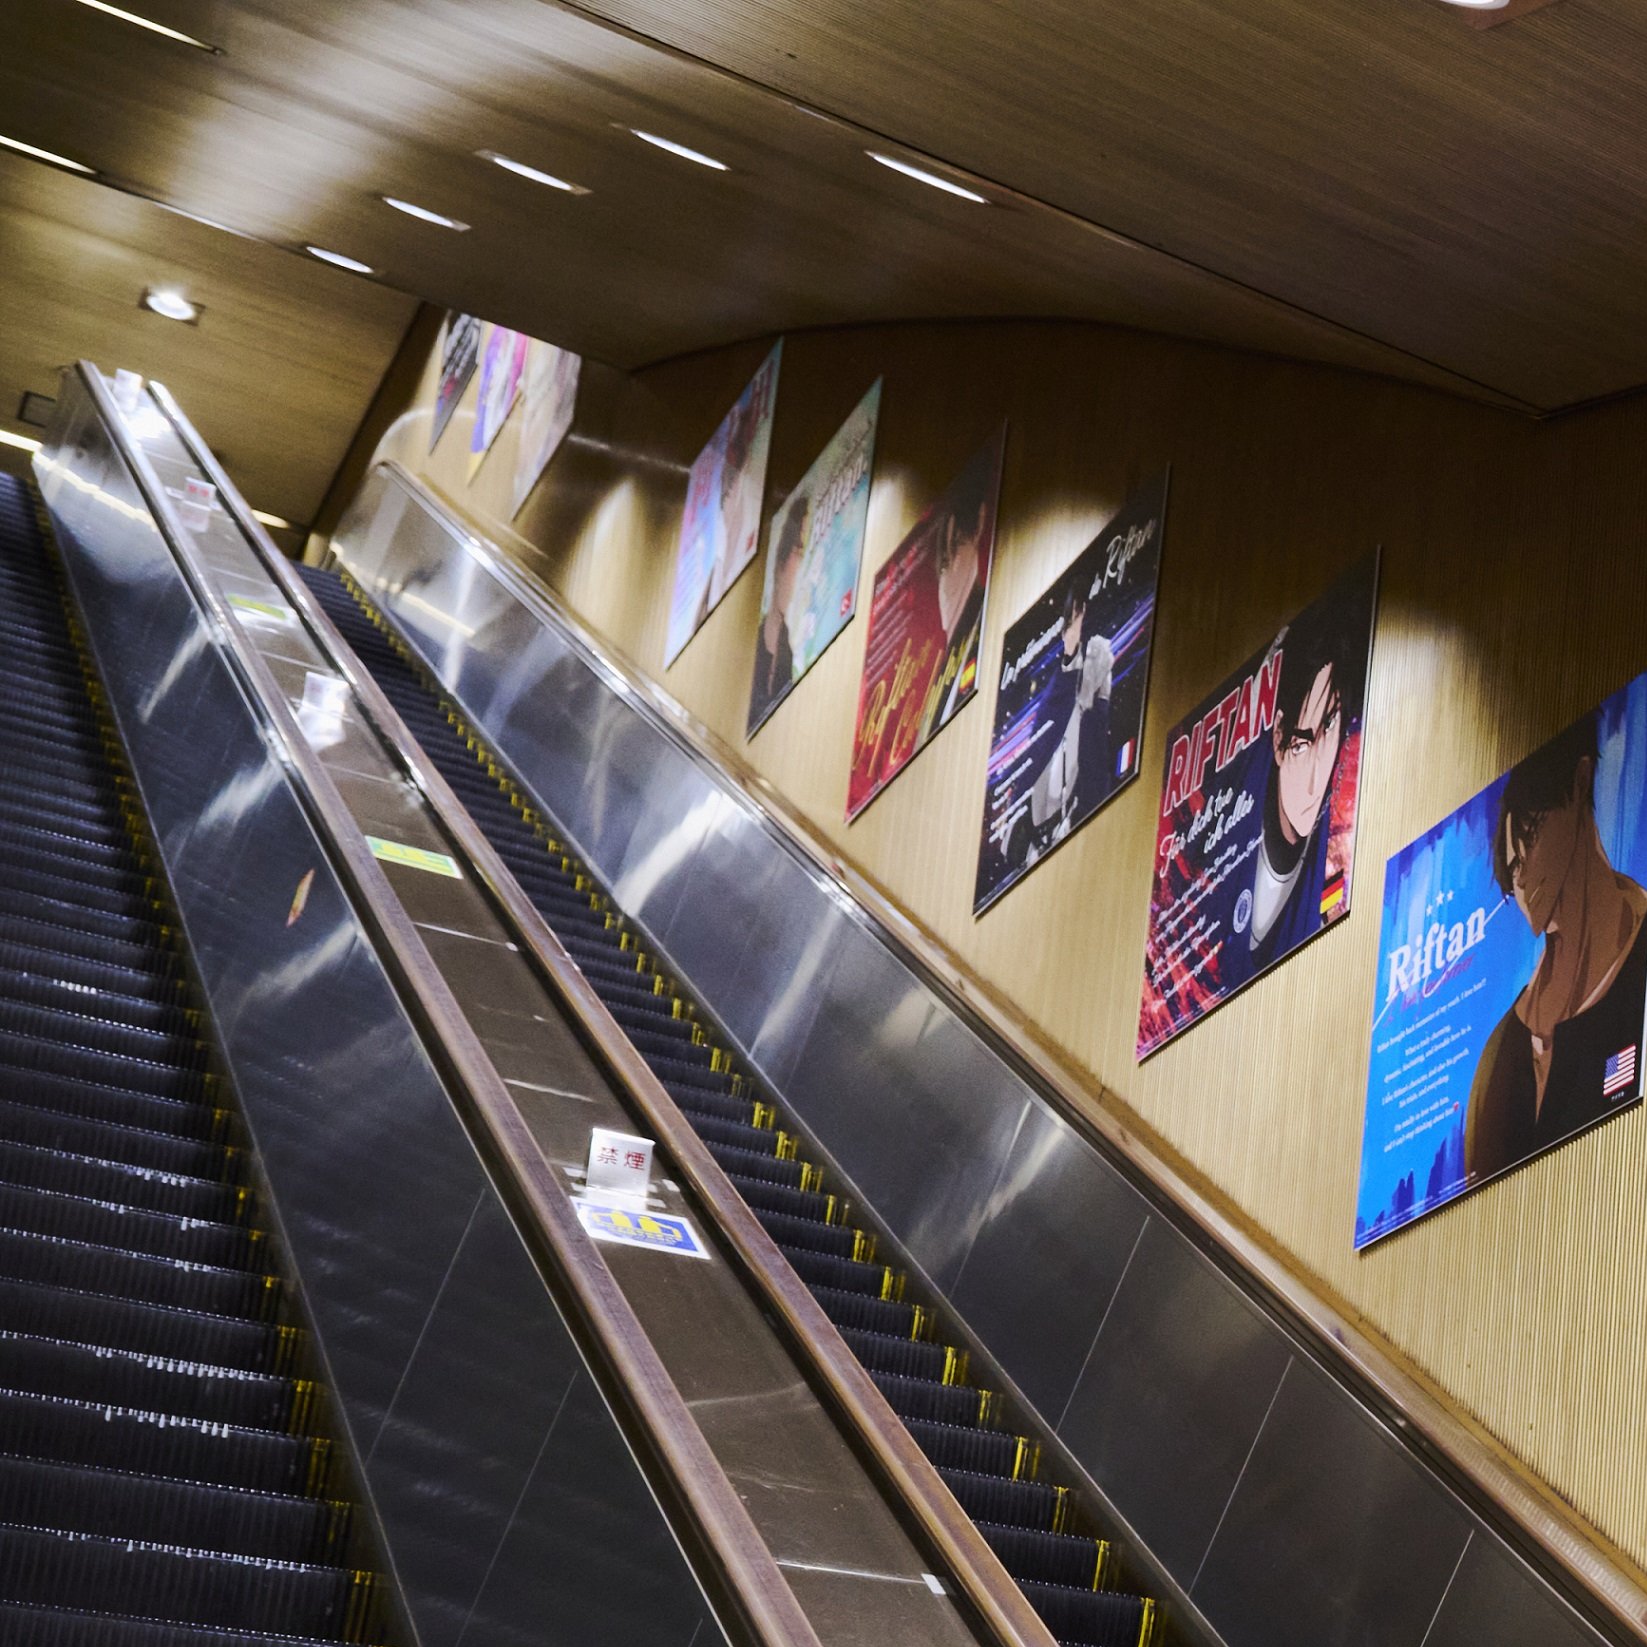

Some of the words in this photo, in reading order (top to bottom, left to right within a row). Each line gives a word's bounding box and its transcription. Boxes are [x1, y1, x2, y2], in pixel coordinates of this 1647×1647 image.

[1163, 649, 1285, 817] RIFTAN
[1385, 907, 1486, 1002] Riftan
[597, 1146, 646, 1171] 禁煙
